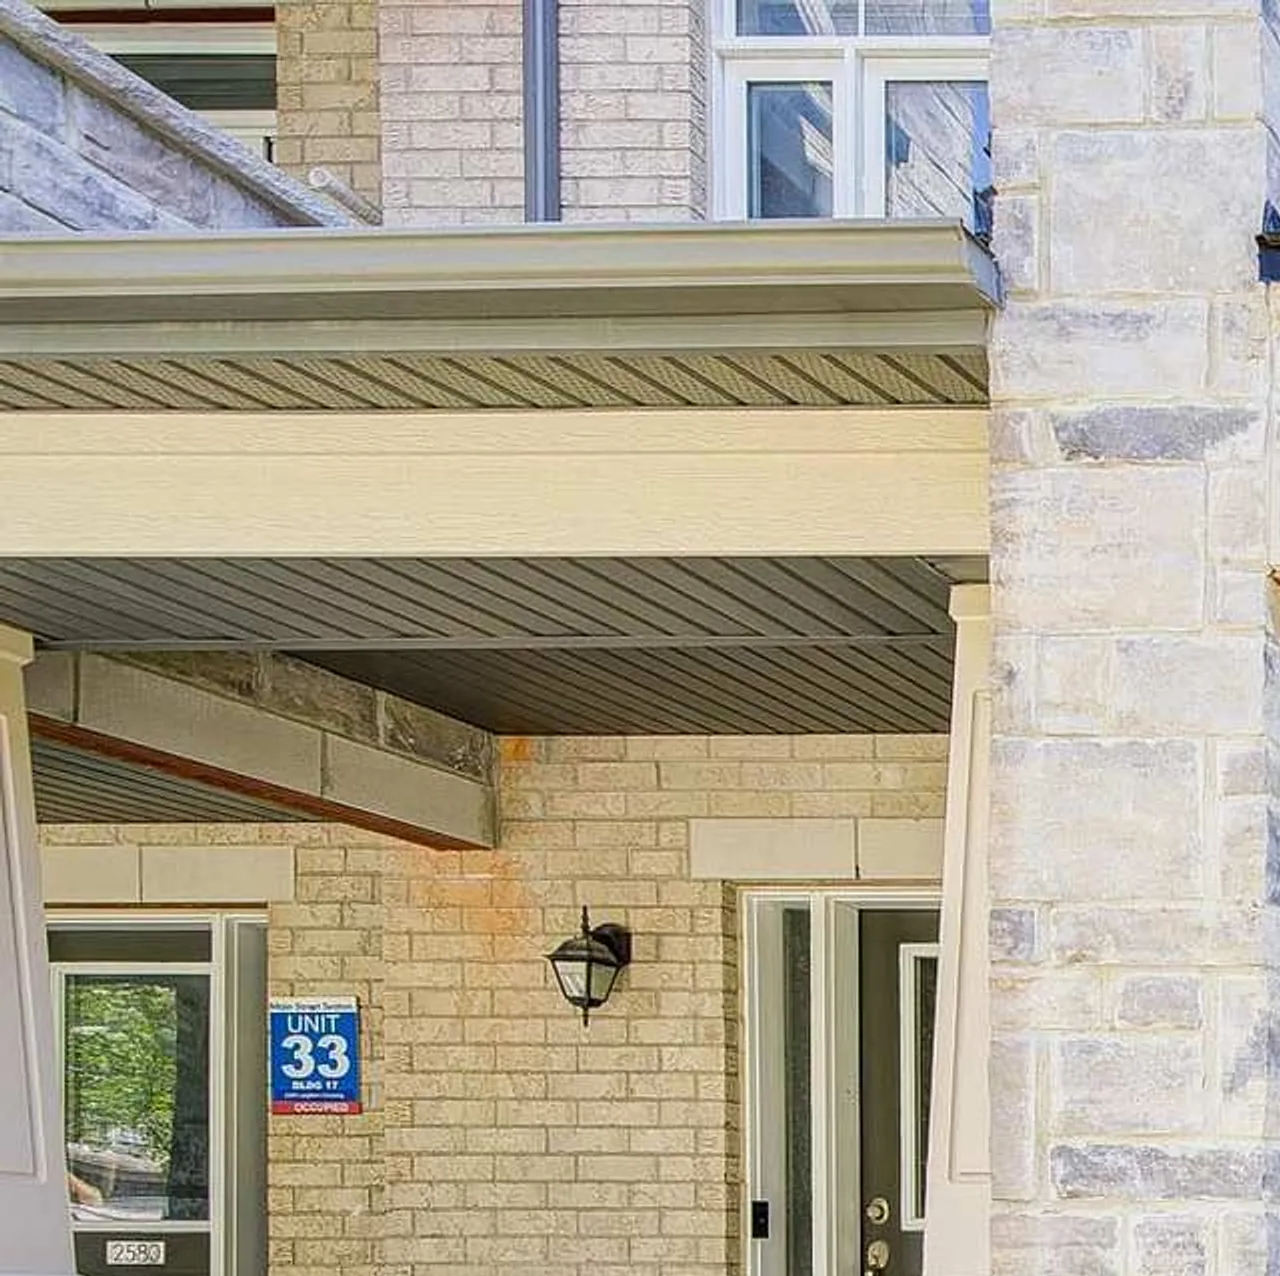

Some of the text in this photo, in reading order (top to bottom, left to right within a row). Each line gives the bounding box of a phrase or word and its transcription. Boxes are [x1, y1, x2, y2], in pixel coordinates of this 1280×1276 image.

[287, 1014, 340, 1033] UNIT
[281, 1034, 351, 1079] 33
[292, 1080, 340, 1090] BLDG 17
[293, 1102, 349, 1113] OCCUPIED
